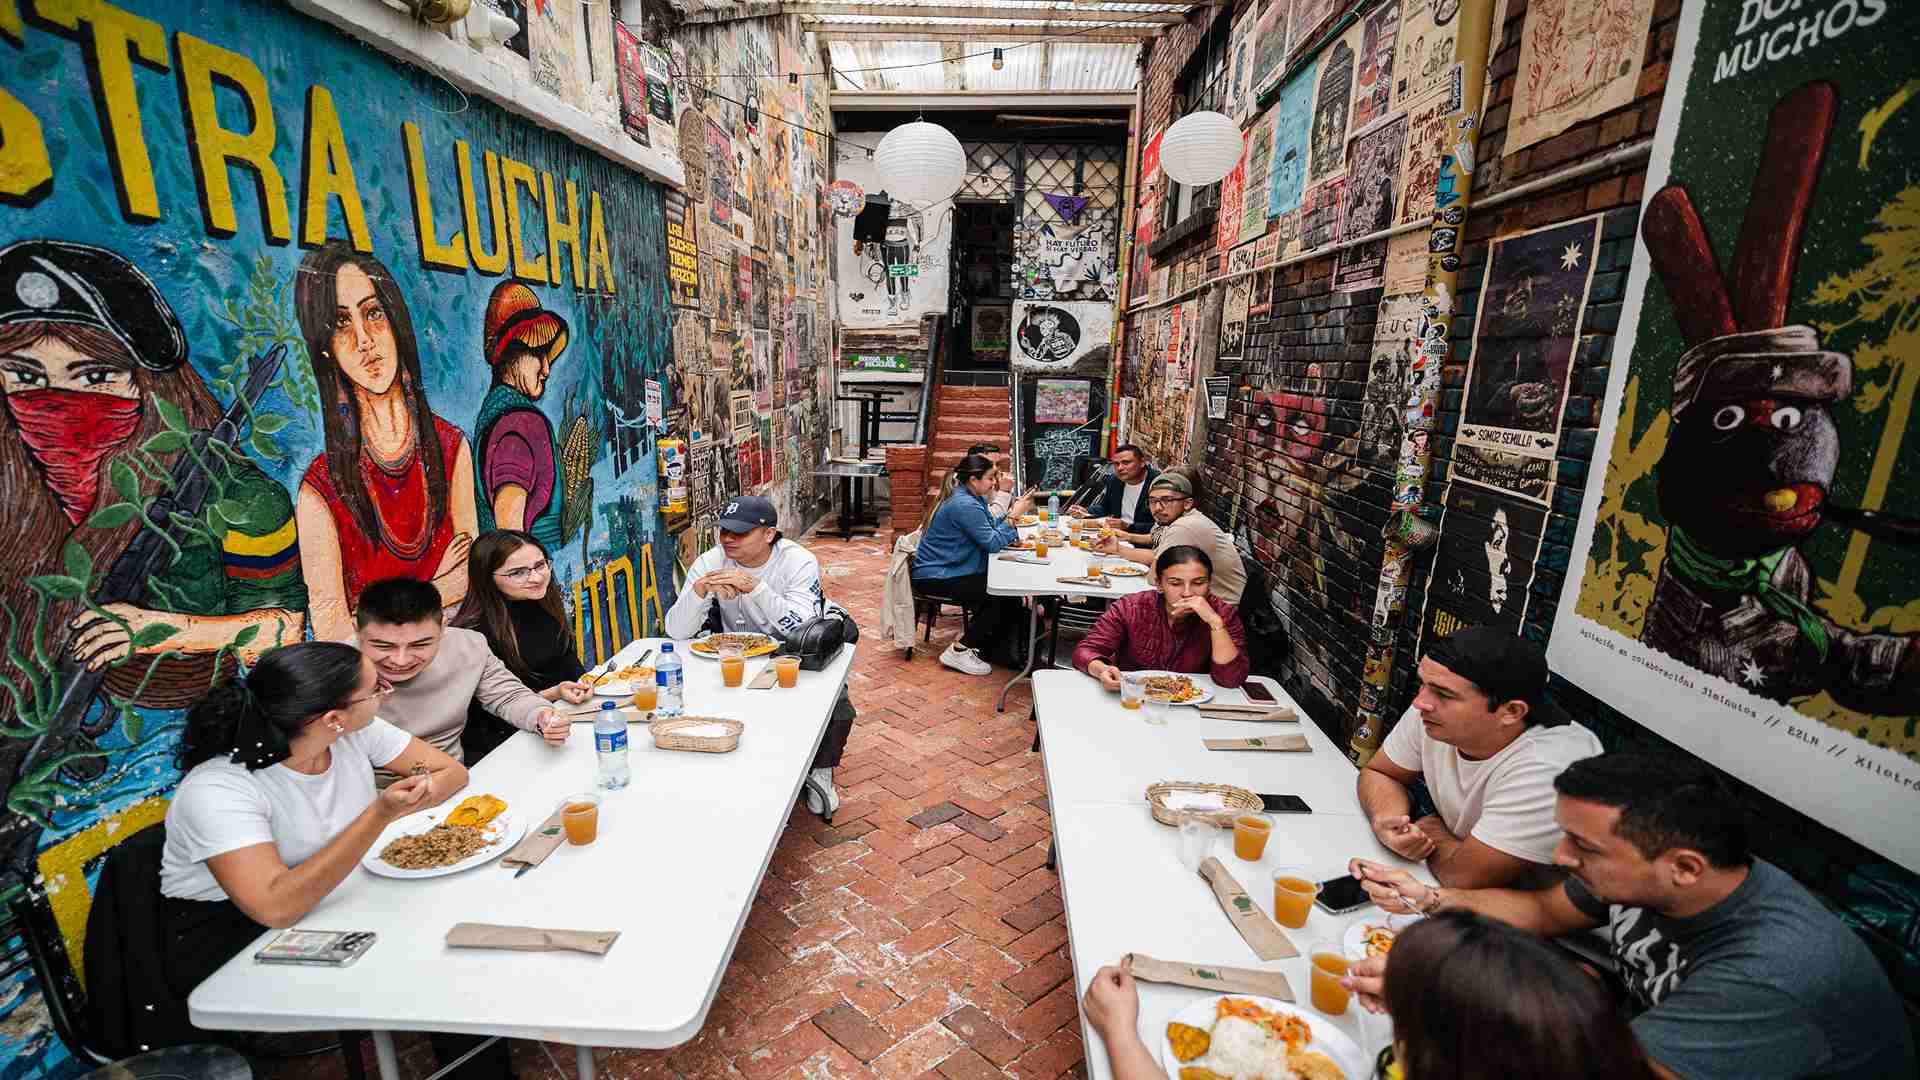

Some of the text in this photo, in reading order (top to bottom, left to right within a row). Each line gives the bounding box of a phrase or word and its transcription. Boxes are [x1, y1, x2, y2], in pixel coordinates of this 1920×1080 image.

[1713, 0, 1887, 84] MUCHOS
[402, 121, 616, 296] LUCHA
[1478, 428, 1533, 448] SOMOS SEMILLA
[1619, 648, 1628, 657] en
